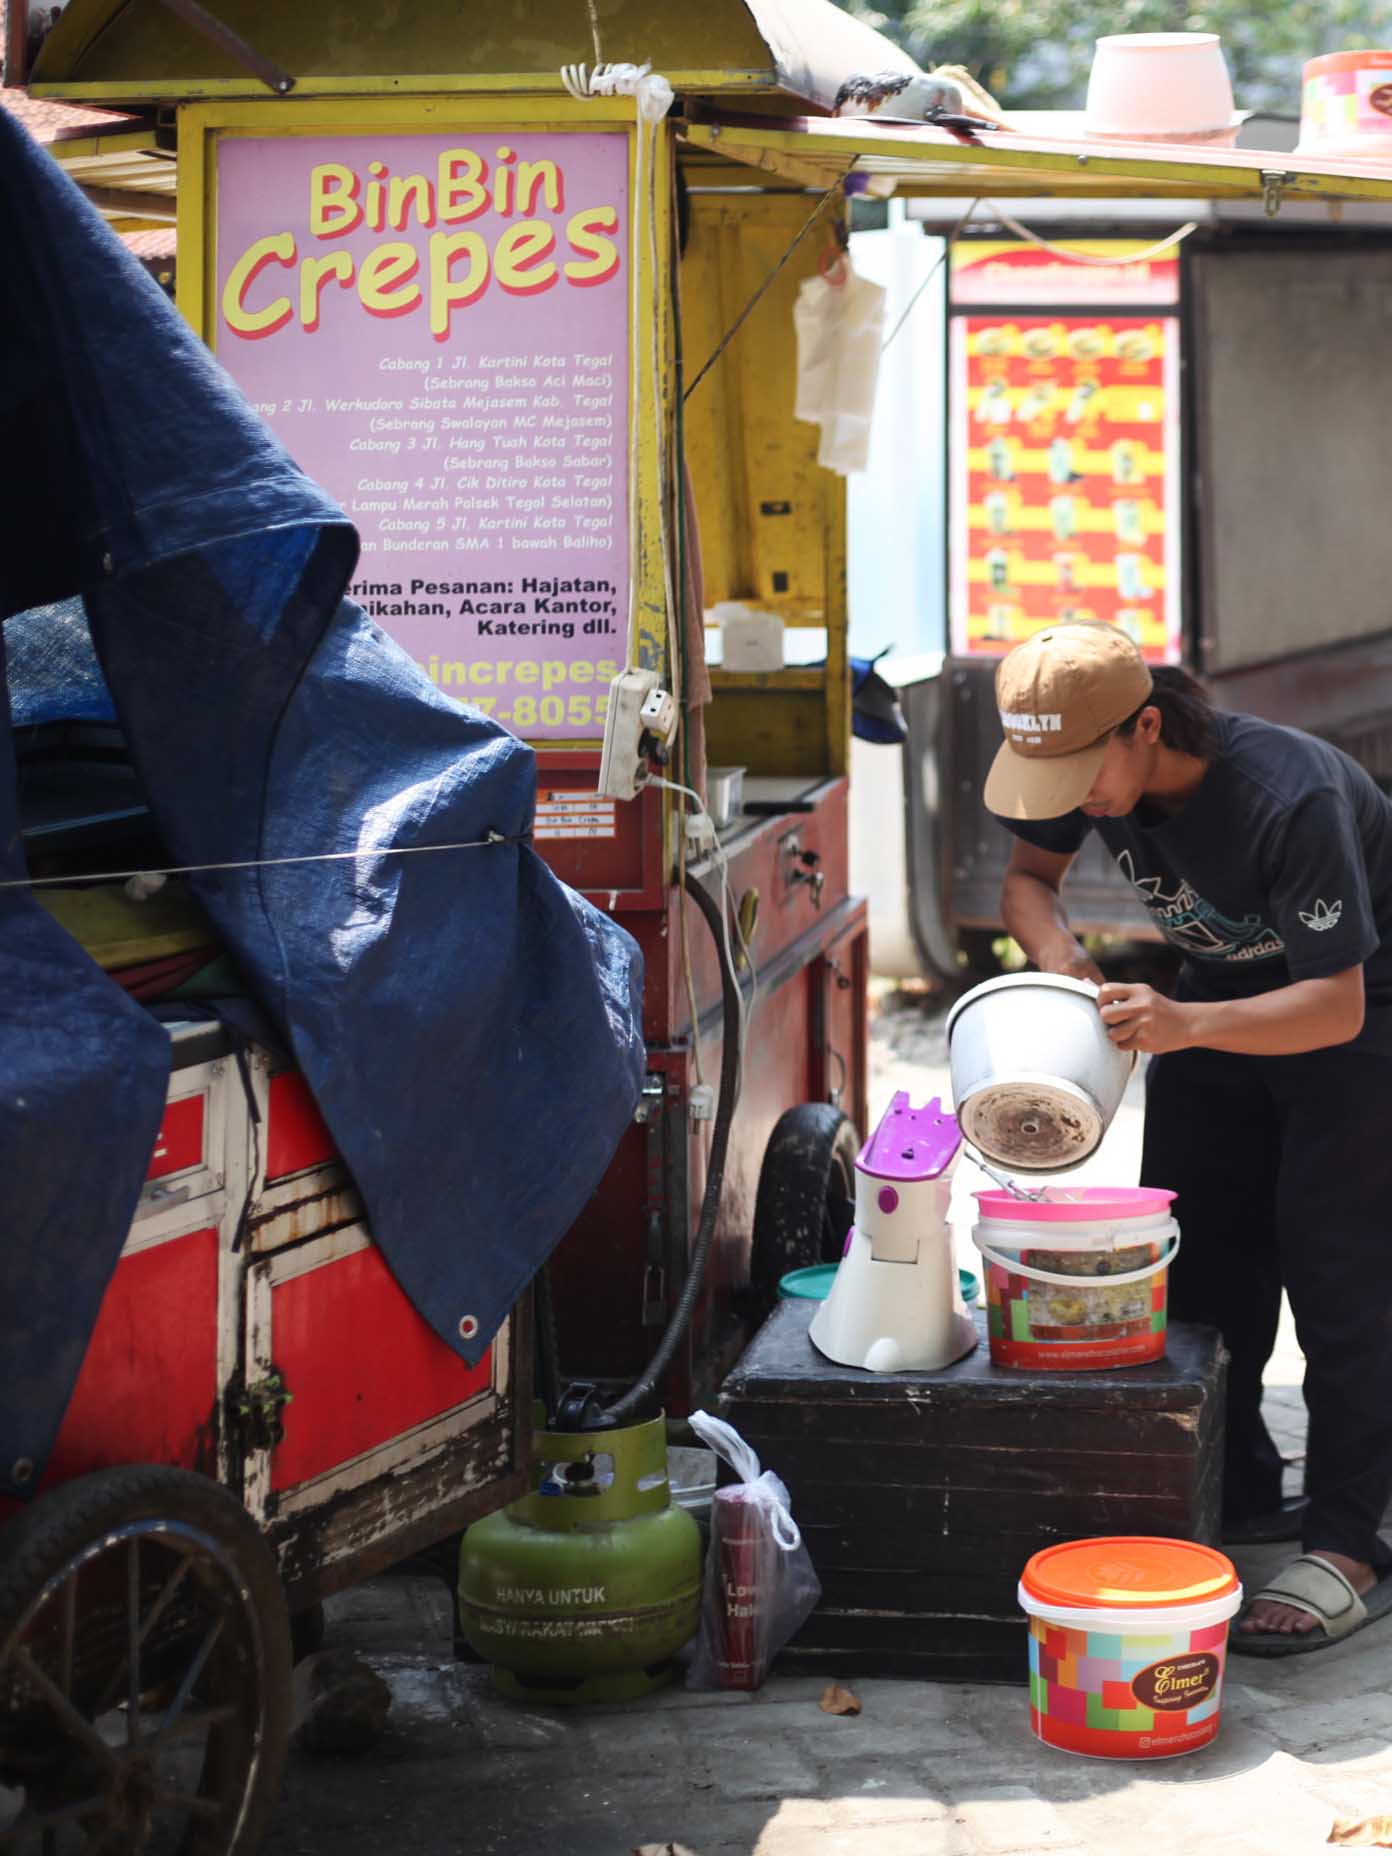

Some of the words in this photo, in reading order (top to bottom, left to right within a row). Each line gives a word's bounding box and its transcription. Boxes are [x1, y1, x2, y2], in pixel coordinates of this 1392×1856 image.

[311, 146, 563, 240] BinBin
[223, 206, 620, 341] Crepes
[379, 357, 430, 373] Cabang
[436, 357, 443, 369] 1
[479, 355, 528, 368] Kartini
[533, 354, 566, 368] Kota
[574, 353, 613, 369] Tegal
[424, 377, 489, 392] (Sebrang
[495, 376, 537, 388] Bakso
[543, 375, 566, 387] Aci
[572, 374, 613, 388] Maci)
[253, 400, 277, 416] ang
[281, 400, 292, 412] 2
[463, 397, 528, 412] Mejasem
[574, 394, 613, 409] Tegal
[369, 417, 435, 433] (Sebrang
[441, 416, 507, 432] Swalayan
[513, 416, 537, 428] MC
[543, 415, 613, 431] Mejasem)
[350, 438, 400, 454] Cabang
[407, 437, 416, 449] 3
[450, 436, 486, 451] Hang
[492, 436, 528, 448] Tuah
[533, 435, 566, 448] Kota
[574, 434, 613, 449] Tegal
[443, 456, 509, 471] (Sebrang
[514, 455, 556, 469] Bakso
[562, 455, 613, 468] Sabar)
[357, 478, 408, 494] Cabang
[414, 477, 424, 489] 4
[457, 476, 479, 489] Cik
[486, 476, 528, 489] Ditiro
[533, 475, 566, 488] Kota
[574, 474, 613, 490] Tegal
[352, 500, 397, 514] Lampu
[402, 498, 449, 510] Merah
[455, 496, 499, 509] Polsek
[505, 495, 545, 511] Tegal
[551, 495, 613, 509] Selatan)
[378, 517, 429, 533] Cabang
[436, 517, 445, 529] 5
[479, 515, 527, 529] Kartini
[533, 515, 566, 528] Kota
[574, 513, 613, 529] Tegal
[383, 538, 449, 551] Bunderan
[455, 537, 489, 550] SMA
[498, 537, 504, 549] 1
[512, 536, 557, 549] bawah
[563, 535, 613, 549] Baliho)
[411, 579, 514, 595] Pesanan:
[522, 578, 617, 597] Hajatan,
[459, 600, 526, 615] Acara
[534, 598, 617, 616] Kantor,
[478, 620, 575, 638] Katering
[583, 619, 617, 635] dll.
[417, 656, 619, 690] increpes
[1226, 939, 1285, 960] adidas
[496, 1587, 545, 1605] HANYA
[549, 1586, 606, 1605] UNTUK
[1154, 1665, 1207, 1696] Elmer
